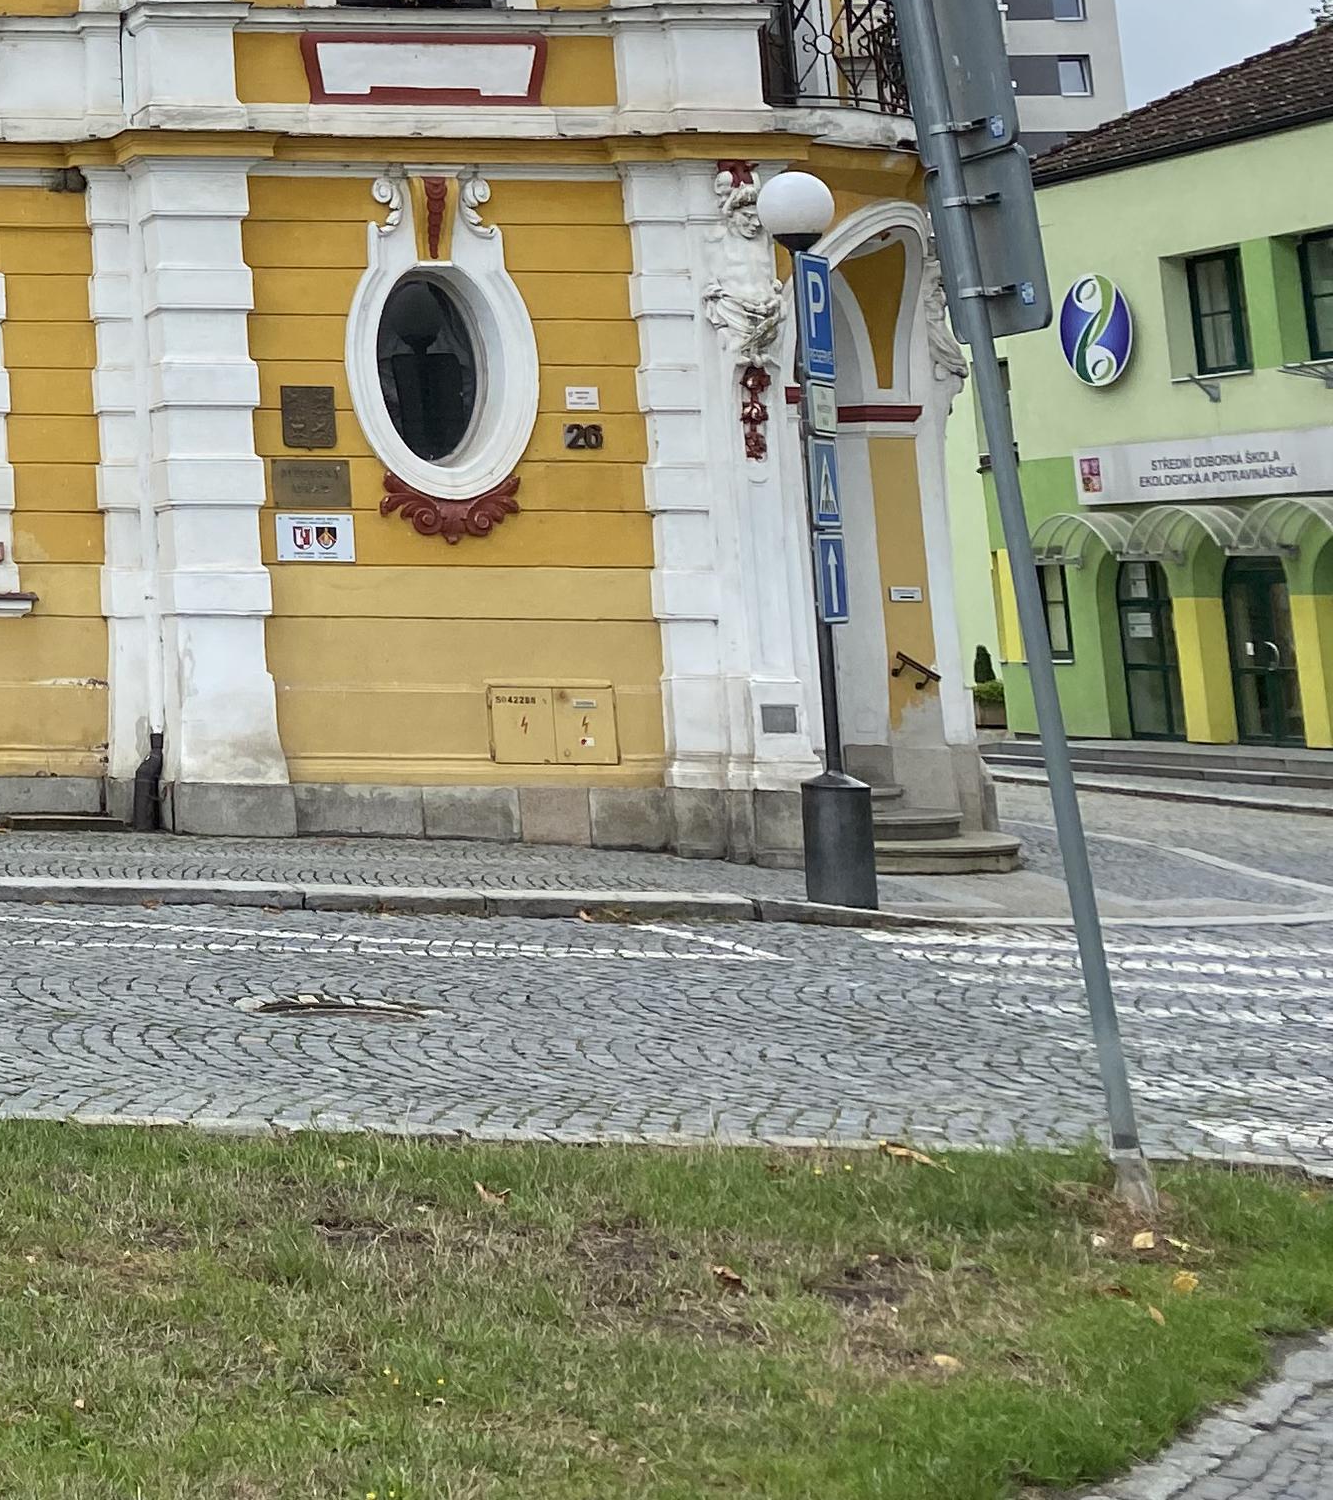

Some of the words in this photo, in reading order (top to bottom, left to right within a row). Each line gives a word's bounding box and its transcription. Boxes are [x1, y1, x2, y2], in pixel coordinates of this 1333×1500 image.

[806, 270, 825, 339] P
[566, 423, 604, 450] 26
[1151, 455, 1192, 471] STŘEDNÍ
[1194, 452, 1243, 468] ODBORNÁ
[1245, 450, 1280, 463] ŠKOLA
[1139, 471, 1202, 487] EKOLOGICKÁ
[1213, 463, 1297, 483] POTRAVINÁŘSKÁ
